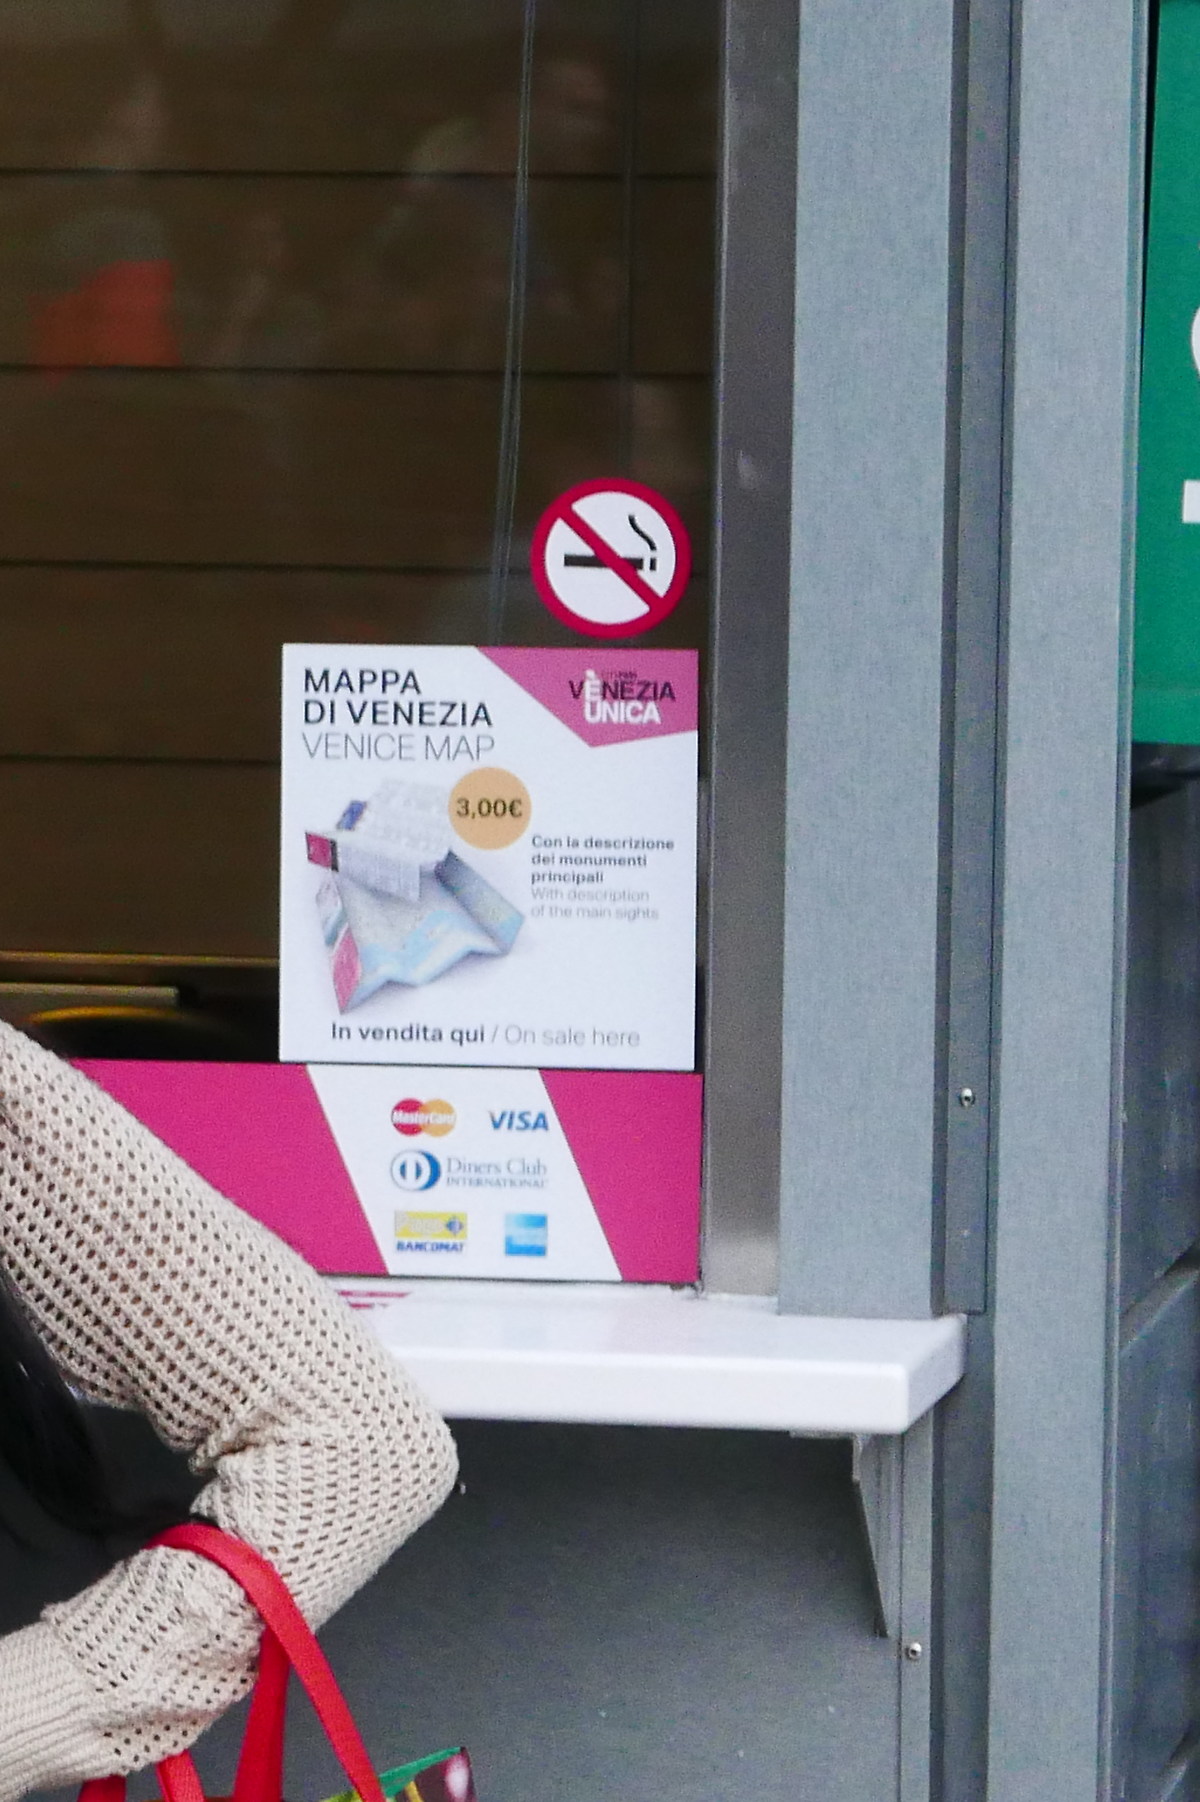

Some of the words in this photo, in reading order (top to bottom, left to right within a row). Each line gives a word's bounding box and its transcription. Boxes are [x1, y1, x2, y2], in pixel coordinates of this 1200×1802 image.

[304, 667, 422, 695] MAPPA
[304, 699, 336, 725] DI
[347, 700, 493, 727] VENEZIA
[302, 731, 415, 761] VENICE
[424, 733, 495, 762] MAP
[456, 798, 523, 819] 3,00€
[531, 835, 563, 849] Con
[567, 836, 579, 849] la
[584, 836, 675, 850] descrizione
[531, 853, 555, 866] dei
[559, 854, 647, 867] monumenti
[531, 871, 604, 885] principali
[531, 887, 564, 900] With
[567, 888, 650, 904] description
[531, 904, 546, 918] of
[548, 905, 572, 918] the
[576, 906, 612, 919] main
[616, 906, 659, 922] sights
[331, 1022, 351, 1040] In
[359, 1023, 443, 1041] vendita
[450, 1025, 485, 1047] qui
[504, 1025, 535, 1044] On
[542, 1026, 585, 1046] sale
[593, 1027, 641, 1047] here
[488, 1110, 550, 1132] VISA
[446, 1157, 502, 1174] Diners
[506, 1157, 548, 1175] Club
[446, 1176, 548, 1189] INTERNATIONAL
